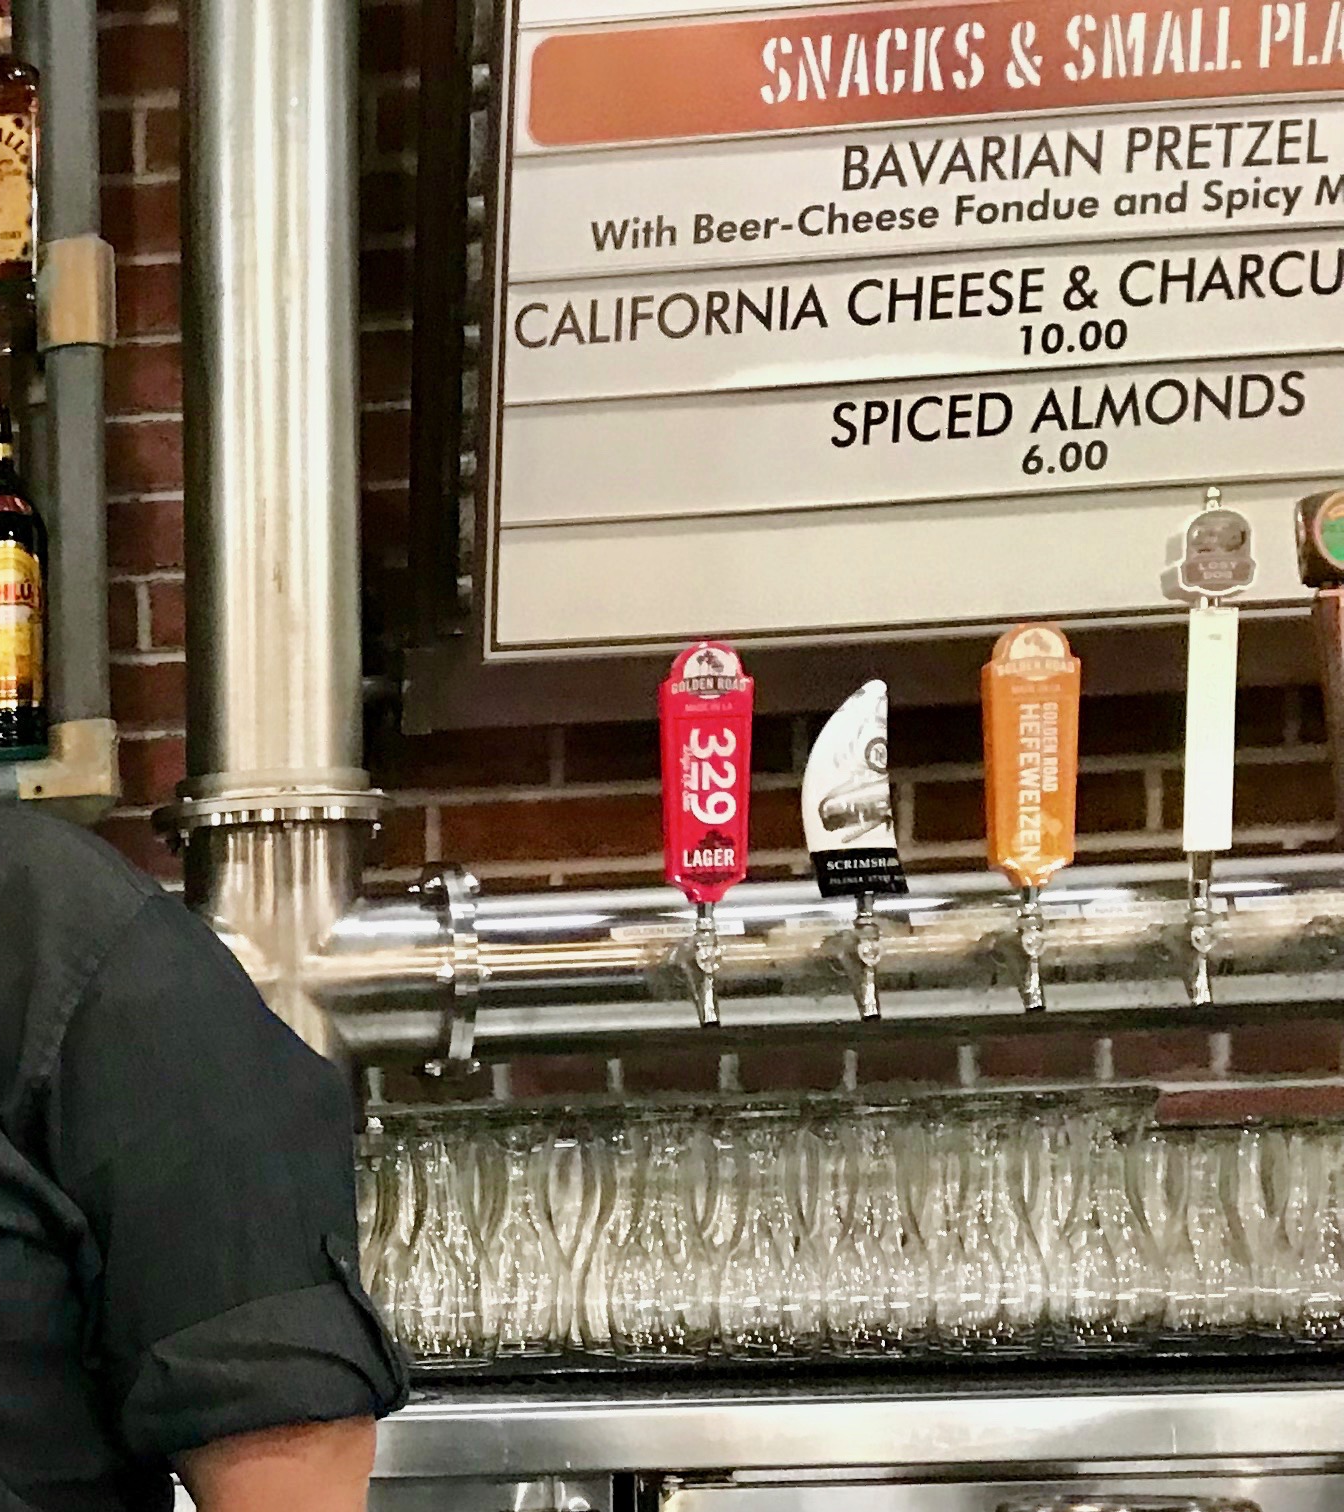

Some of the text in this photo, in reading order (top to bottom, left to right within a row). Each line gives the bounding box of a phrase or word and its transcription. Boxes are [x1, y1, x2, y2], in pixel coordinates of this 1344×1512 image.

[760, 22, 984, 106] SNACKS
[1006, 20, 1043, 89] &
[1064, 7, 1242, 82] SMALL
[843, 118, 1329, 192] BAVARIAN PRETZEL
[591, 215, 678, 253] With
[693, 202, 940, 246] Beer-Cheese
[955, 188, 1099, 227] Fondue
[1114, 180, 1188, 217] and
[1202, 176, 1303, 219] Spicy
[515, 284, 828, 349] CALIFORNIA
[847, 268, 1045, 327] CHEESE
[1063, 264, 1099, 312] &
[1019, 318, 1129, 356] 10.00
[830, 371, 1307, 449] SPICED ALMONDS
[1021, 439, 1110, 478] 6.00
[671, 676, 715, 695] GOLDEN
[689, 727, 738, 825] 329
[1019, 703, 1042, 863] HEFEWEIZEN
[1042, 702, 1059, 793] GOLDEN ROAD
[683, 848, 736, 868] LAGER
